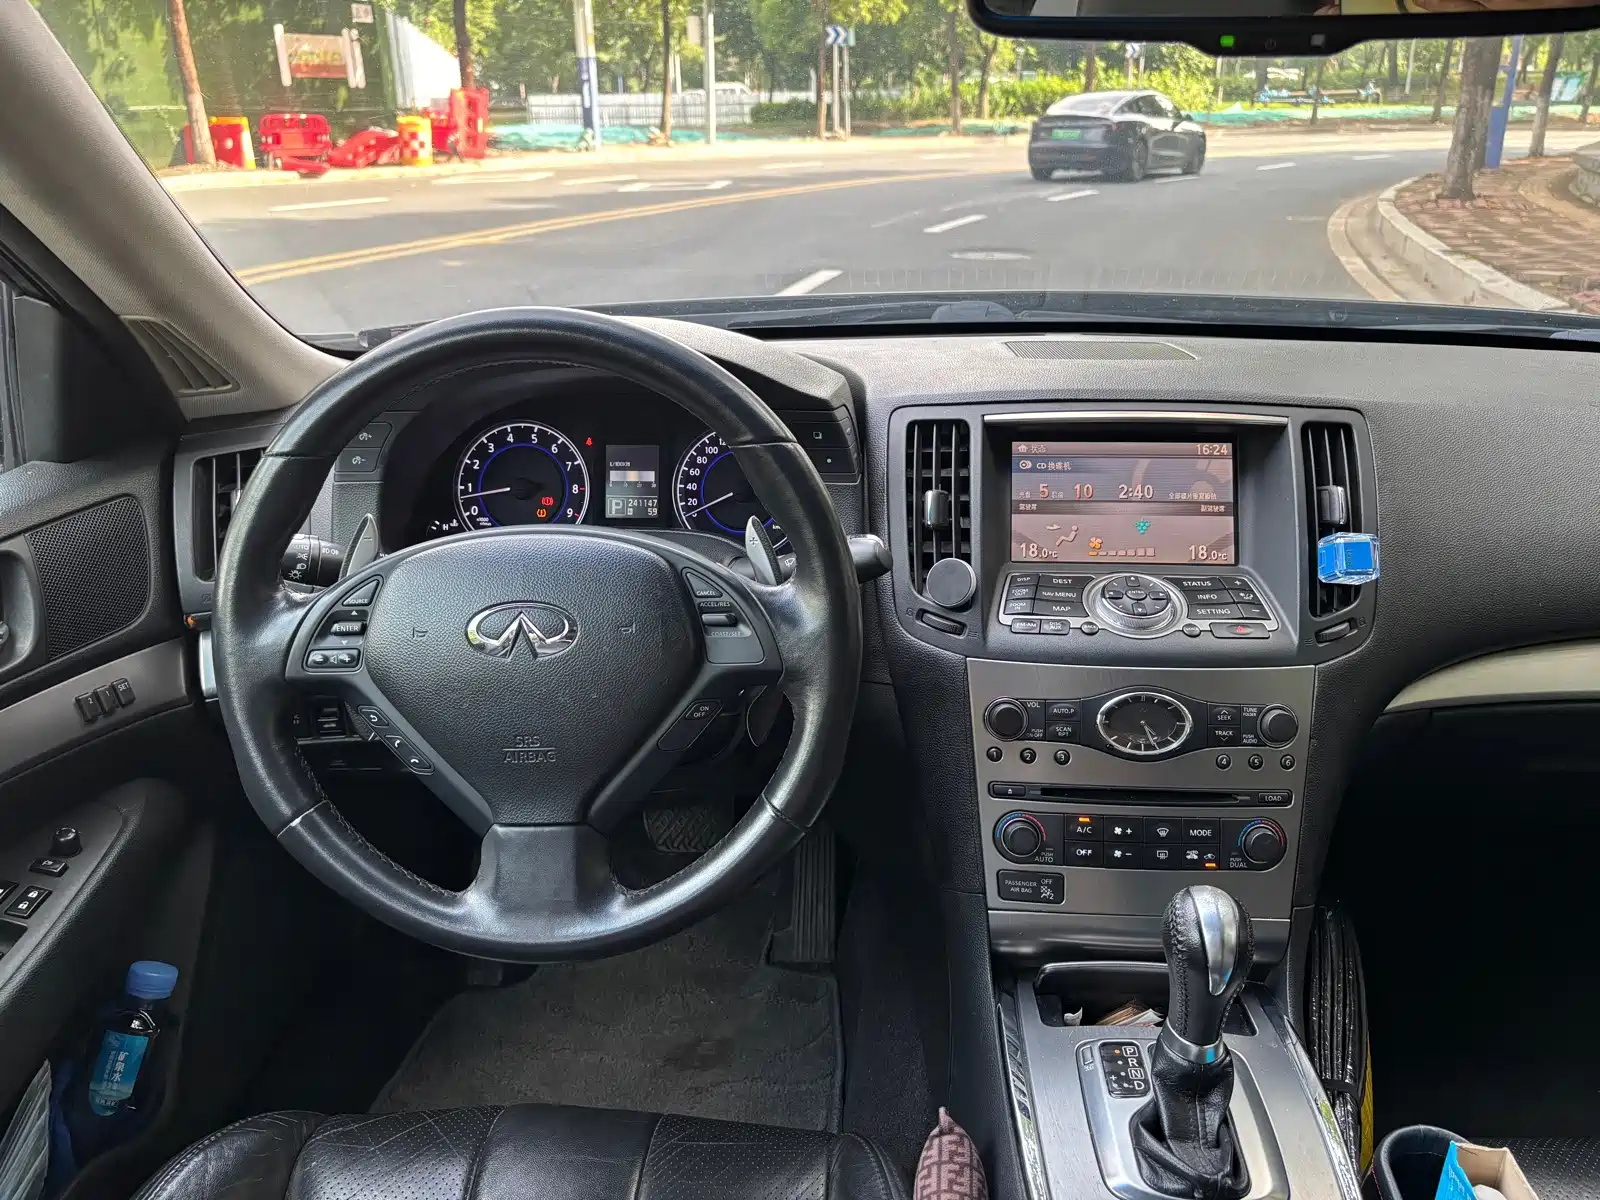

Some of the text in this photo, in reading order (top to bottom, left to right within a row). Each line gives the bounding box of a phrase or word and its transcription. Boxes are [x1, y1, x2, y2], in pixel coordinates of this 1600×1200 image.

[506, 433, 514, 443] 4
[531, 434, 538, 444] 5
[488, 443, 495, 453] 3
[551, 444, 558, 454] 6
[705, 446, 719, 454] 100
[1196, 444, 1228, 455] 16:24
[472, 459, 480, 470] 2
[696, 456, 708, 464] 80
[565, 461, 572, 472] 7
[689, 468, 700, 476] 60
[467, 482, 472, 493] 1
[572, 484, 579, 494] 8
[686, 483, 698, 491] 40
[1039, 484, 1049, 499] 5
[1074, 483, 1094, 499] 10
[1118, 484, 1154, 499] 2:40
[628, 499, 658, 507] 241147
[687, 498, 698, 506] 20
[471, 505, 479, 516] 0
[612, 500, 623, 515] P
[566, 508, 573, 518] 9
[442, 523, 449, 531] H
[336, 624, 359, 632] ENTER
[118, 682, 129, 692] SET
[503, 751, 556, 763] AIRBAG
[111, 1051, 129, 1081] 矿泉水
[1128, 1058, 1139, 1067] R
[1133, 1080, 1145, 1090] D
